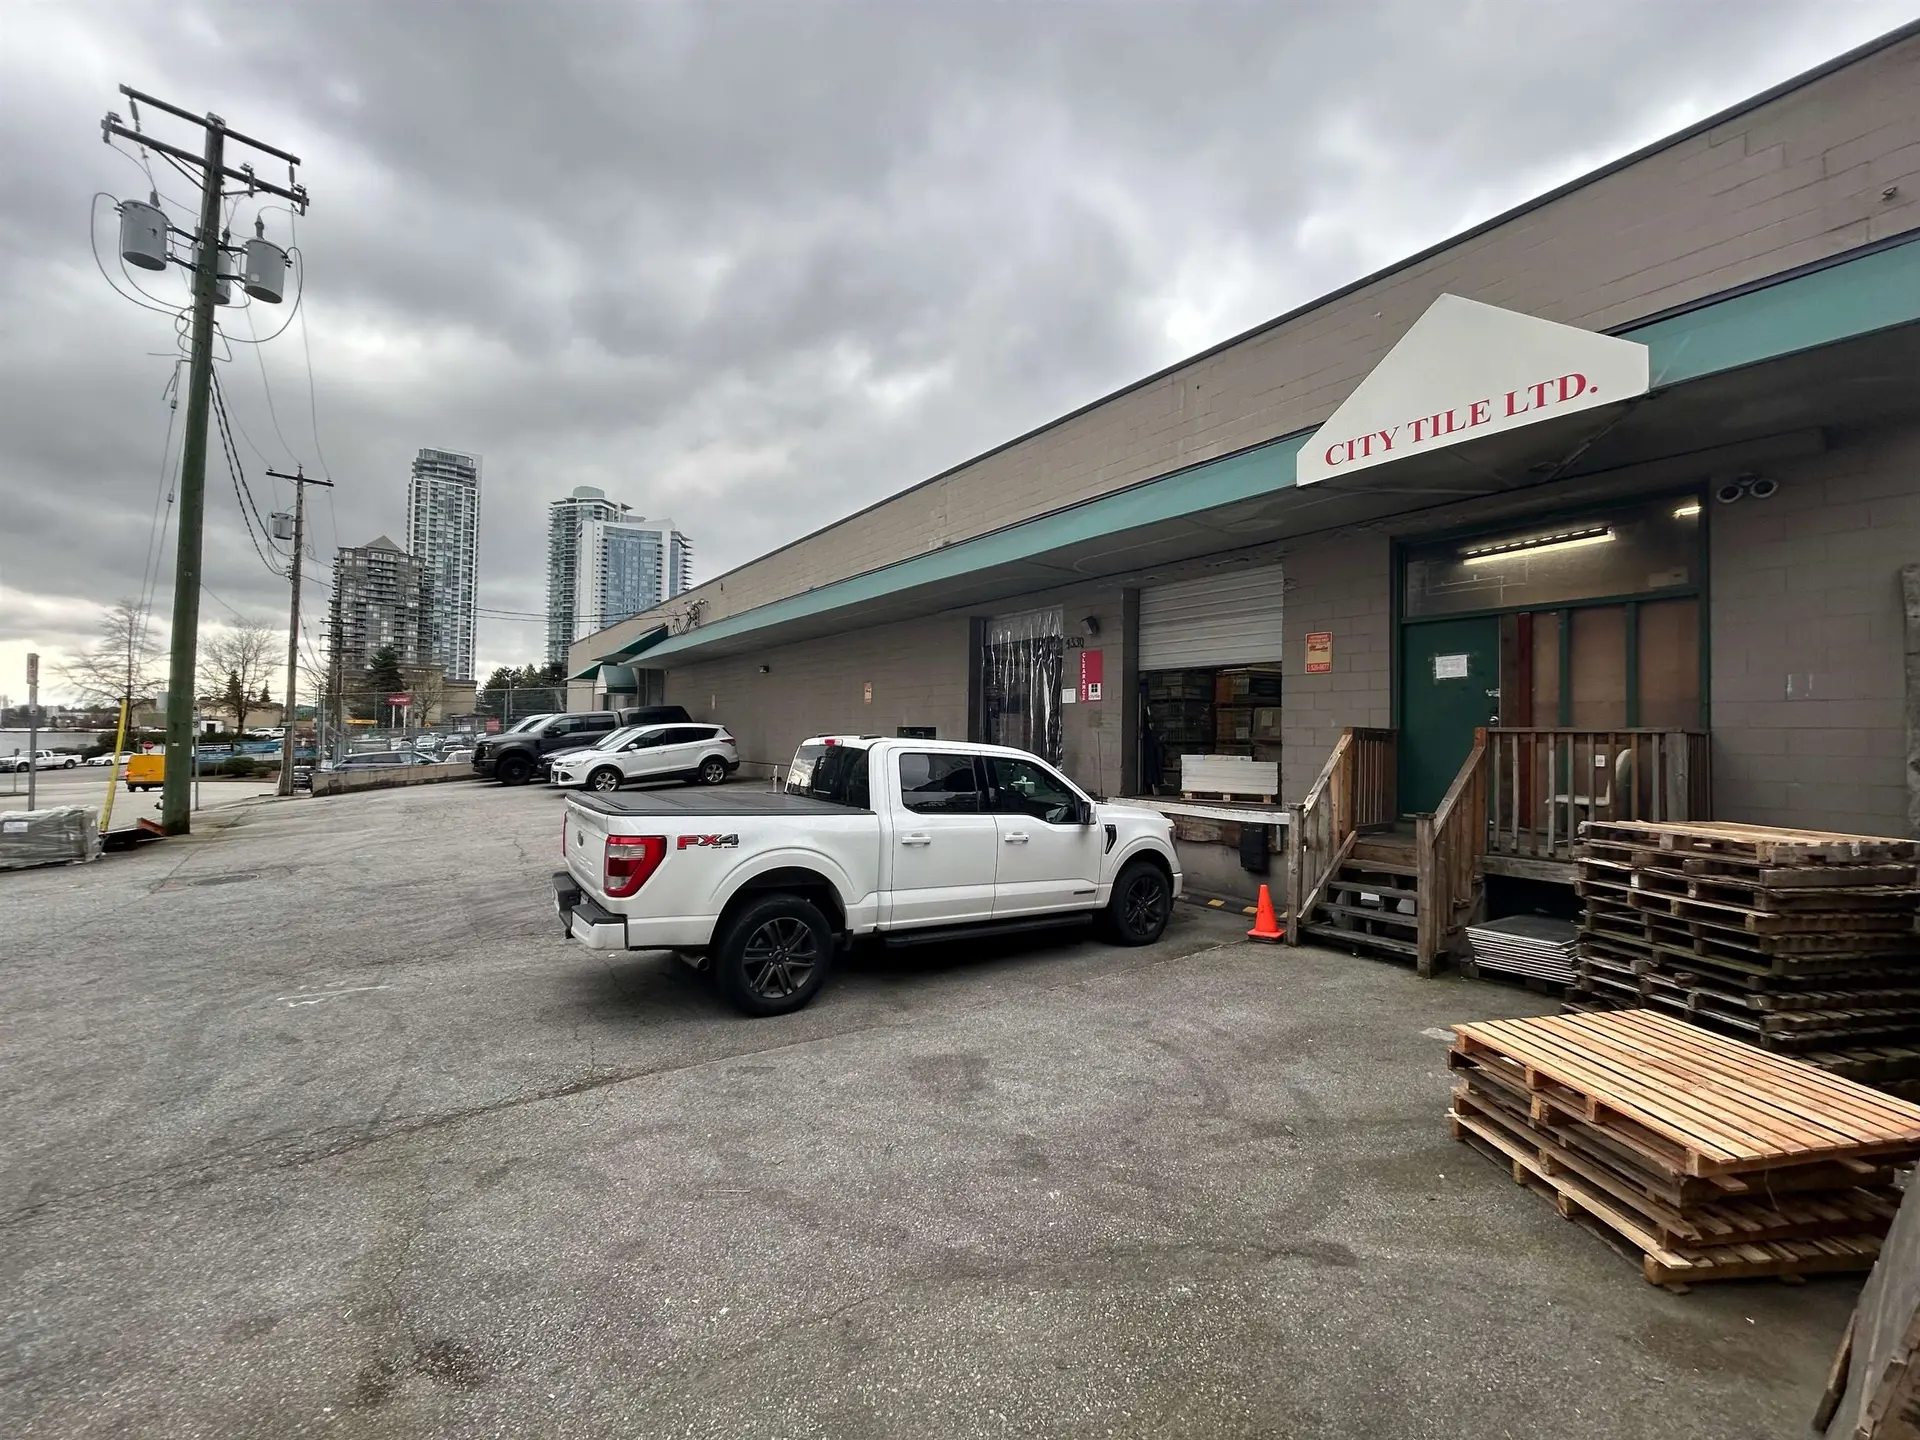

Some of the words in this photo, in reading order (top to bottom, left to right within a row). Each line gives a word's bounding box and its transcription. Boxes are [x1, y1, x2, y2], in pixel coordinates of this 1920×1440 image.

[1325, 426, 1400, 466] CITY
[1407, 399, 1492, 443] TILE
[1504, 373, 1598, 418] LTD.
[677, 834, 739, 850] FX4
